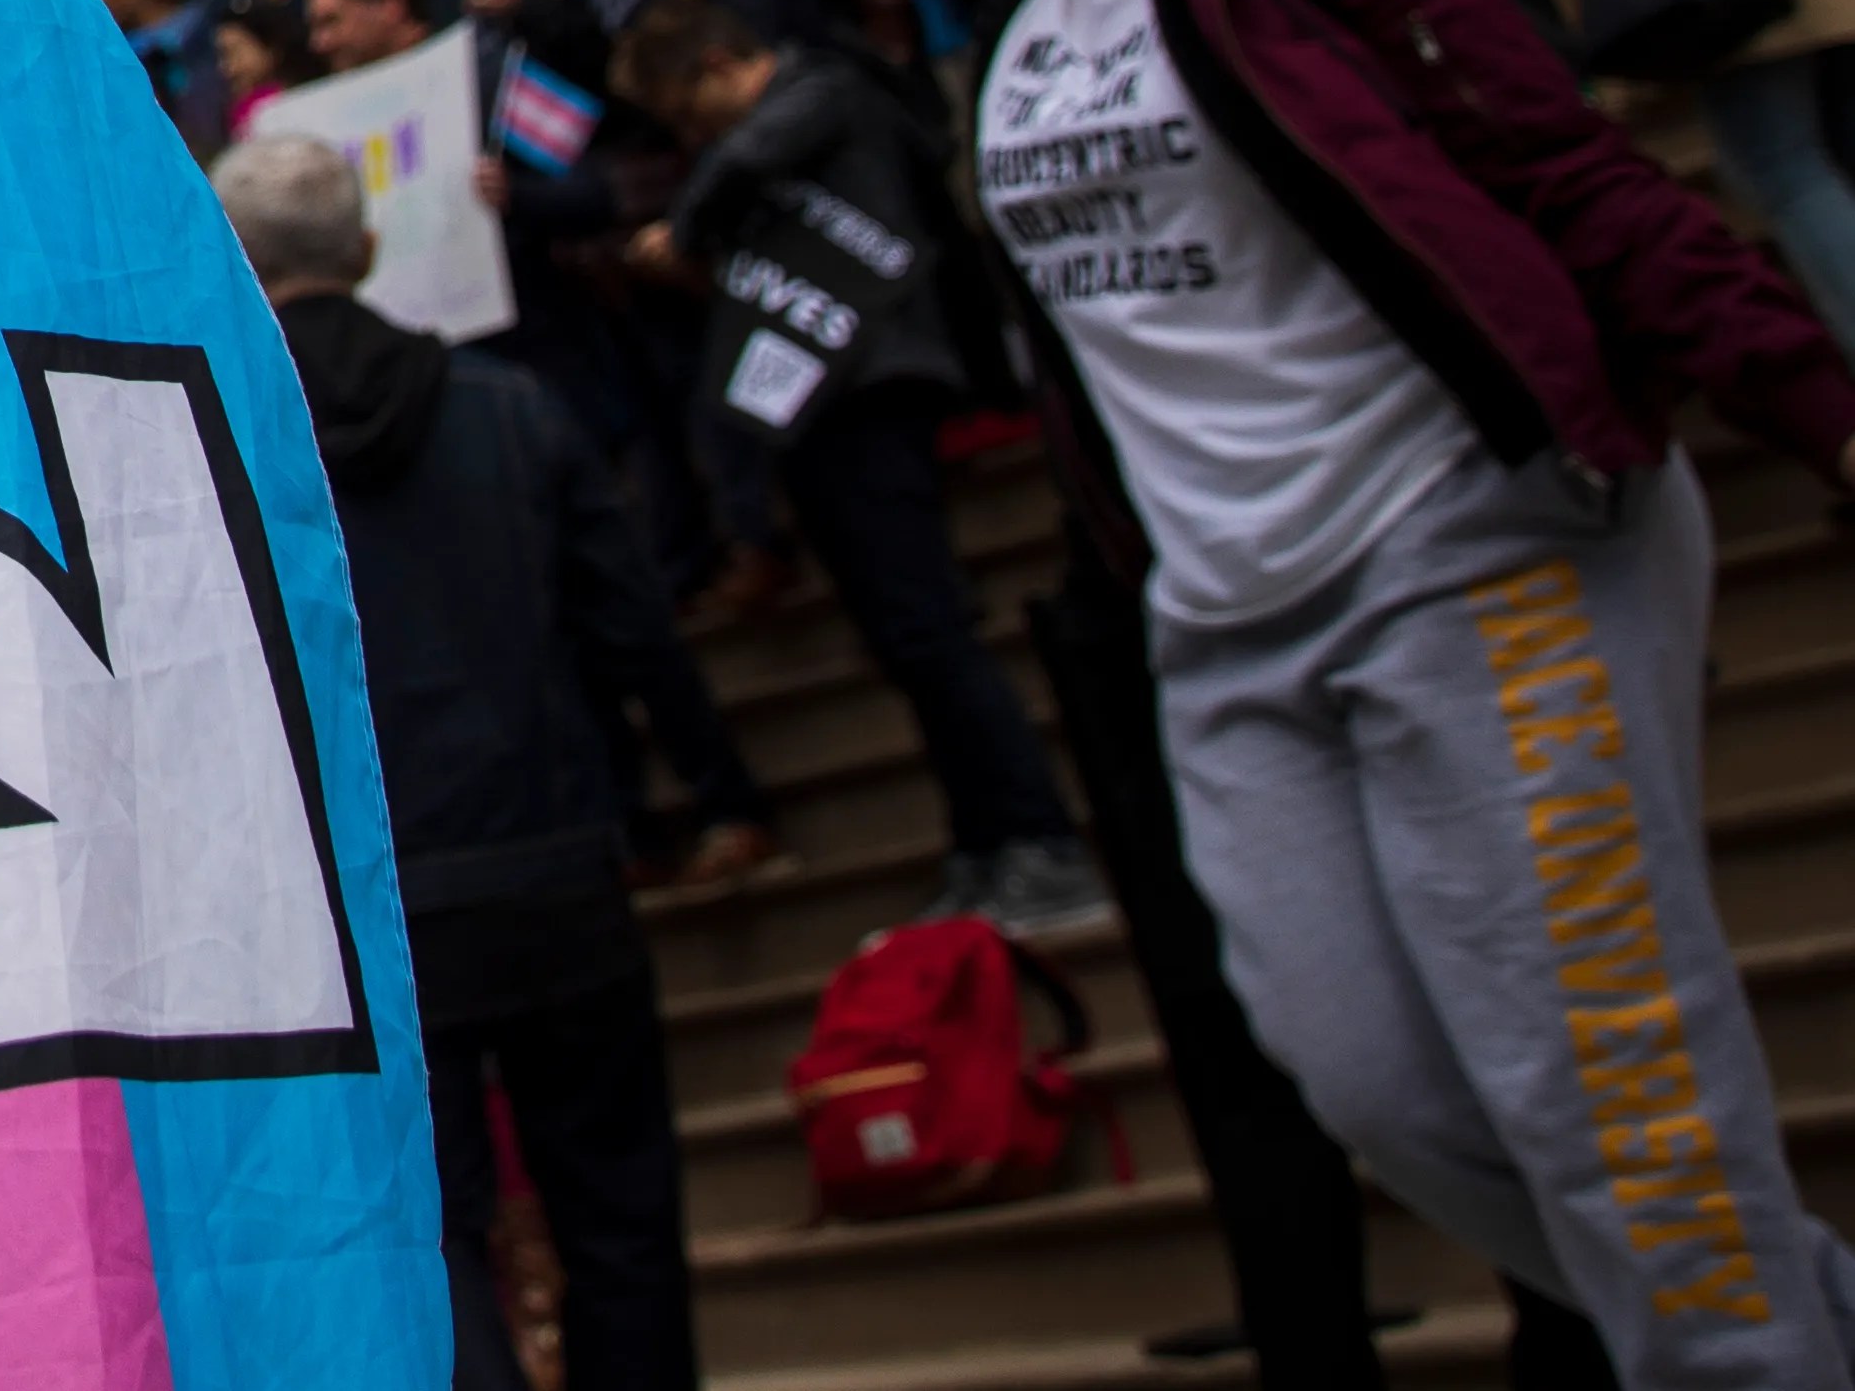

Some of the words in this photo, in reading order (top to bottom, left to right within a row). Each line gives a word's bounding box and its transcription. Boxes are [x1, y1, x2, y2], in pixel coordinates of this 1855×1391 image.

[983, 118, 1198, 188] ROCENTRIC
[1020, 241, 1219, 302] ANDARDS
[1469, 560, 1624, 772] PACE
[1528, 782, 1771, 1325] UNIVERSITY
